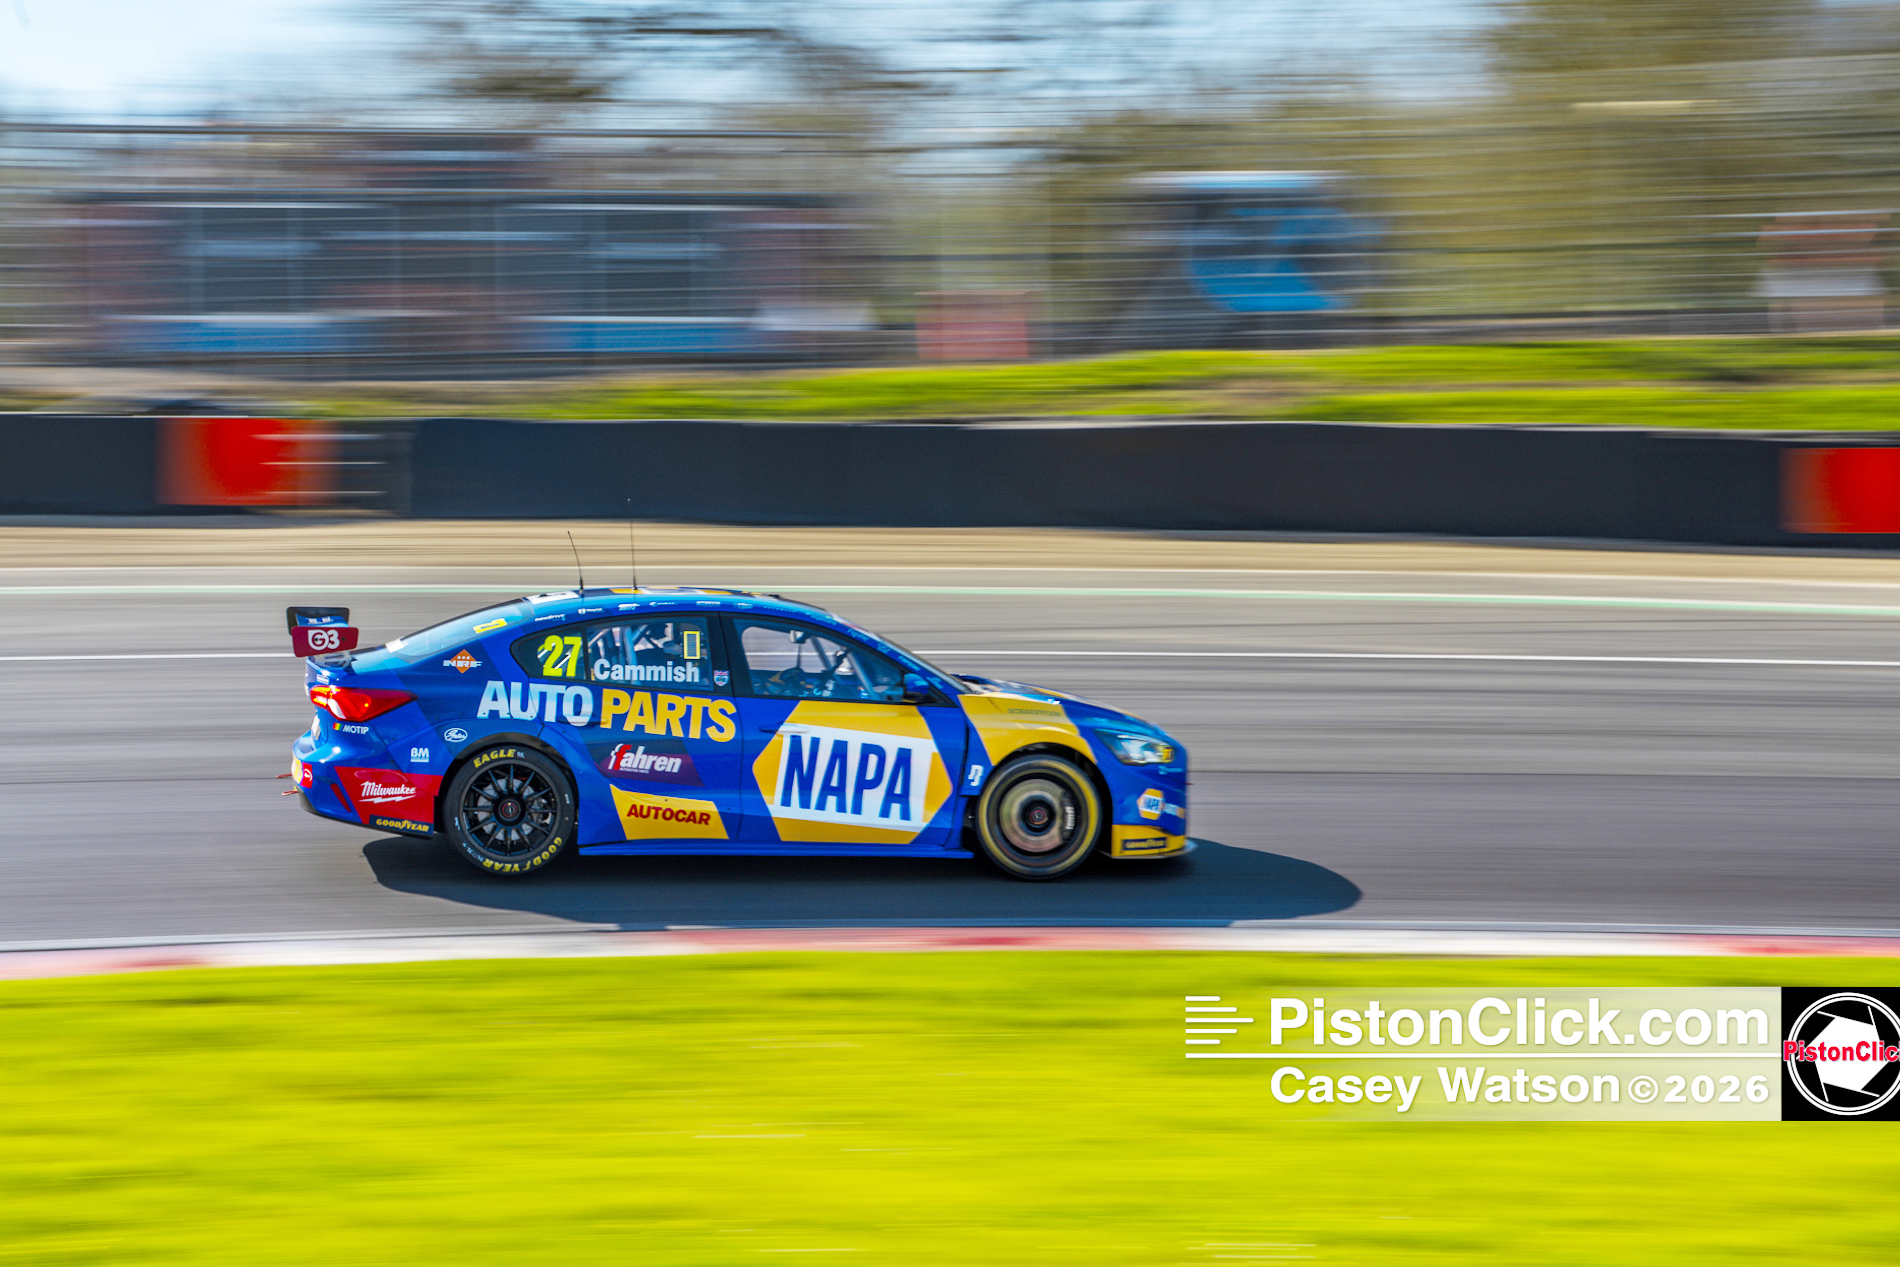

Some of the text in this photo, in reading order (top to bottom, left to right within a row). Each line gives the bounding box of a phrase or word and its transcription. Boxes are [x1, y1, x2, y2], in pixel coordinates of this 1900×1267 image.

[307, 629, 340, 651] G3
[443, 659, 483, 668] NRF
[542, 634, 582, 678] 27
[593, 658, 700, 684] Cammish
[476, 680, 738, 743] AUTO PARTS
[342, 724, 370, 735] MOTIP
[473, 748, 516, 768] EAGLE
[608, 743, 682, 774] fahren
[360, 781, 416, 797] Milwaukee
[780, 734, 912, 822] NAPA
[375, 818, 430, 832] GOODYEAR
[626, 804, 711, 826] AUTOCAR
[482, 836, 563, 872] GOODYEAR
